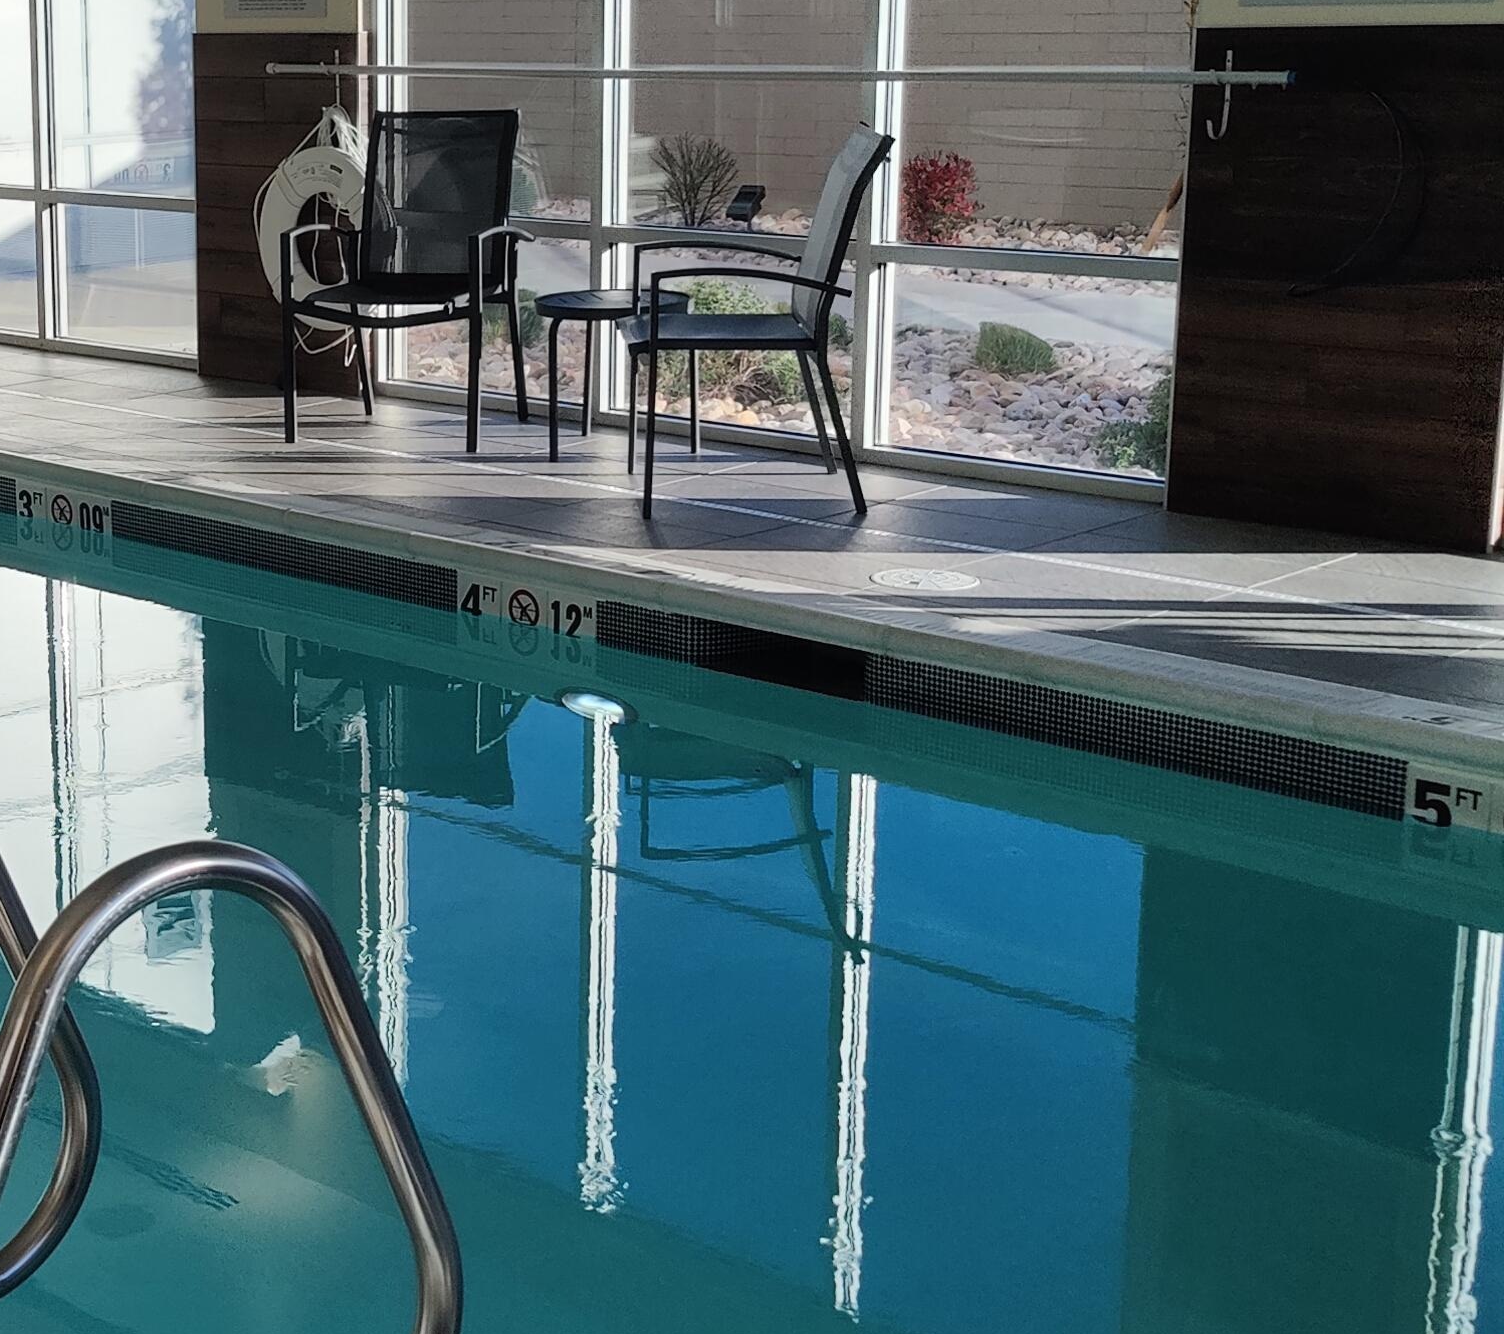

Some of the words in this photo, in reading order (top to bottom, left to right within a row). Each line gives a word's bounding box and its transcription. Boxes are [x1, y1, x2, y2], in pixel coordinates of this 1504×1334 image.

[18, 489, 34, 518] 3
[33, 492, 44, 506] FT
[79, 502, 104, 534] 09
[460, 583, 482, 616] 4
[482, 586, 498, 602] FT
[551, 600, 582, 639] 12
[582, 606, 593, 619] M
[1411, 779, 1452, 827] 5
[1455, 787, 1483, 811] FT
